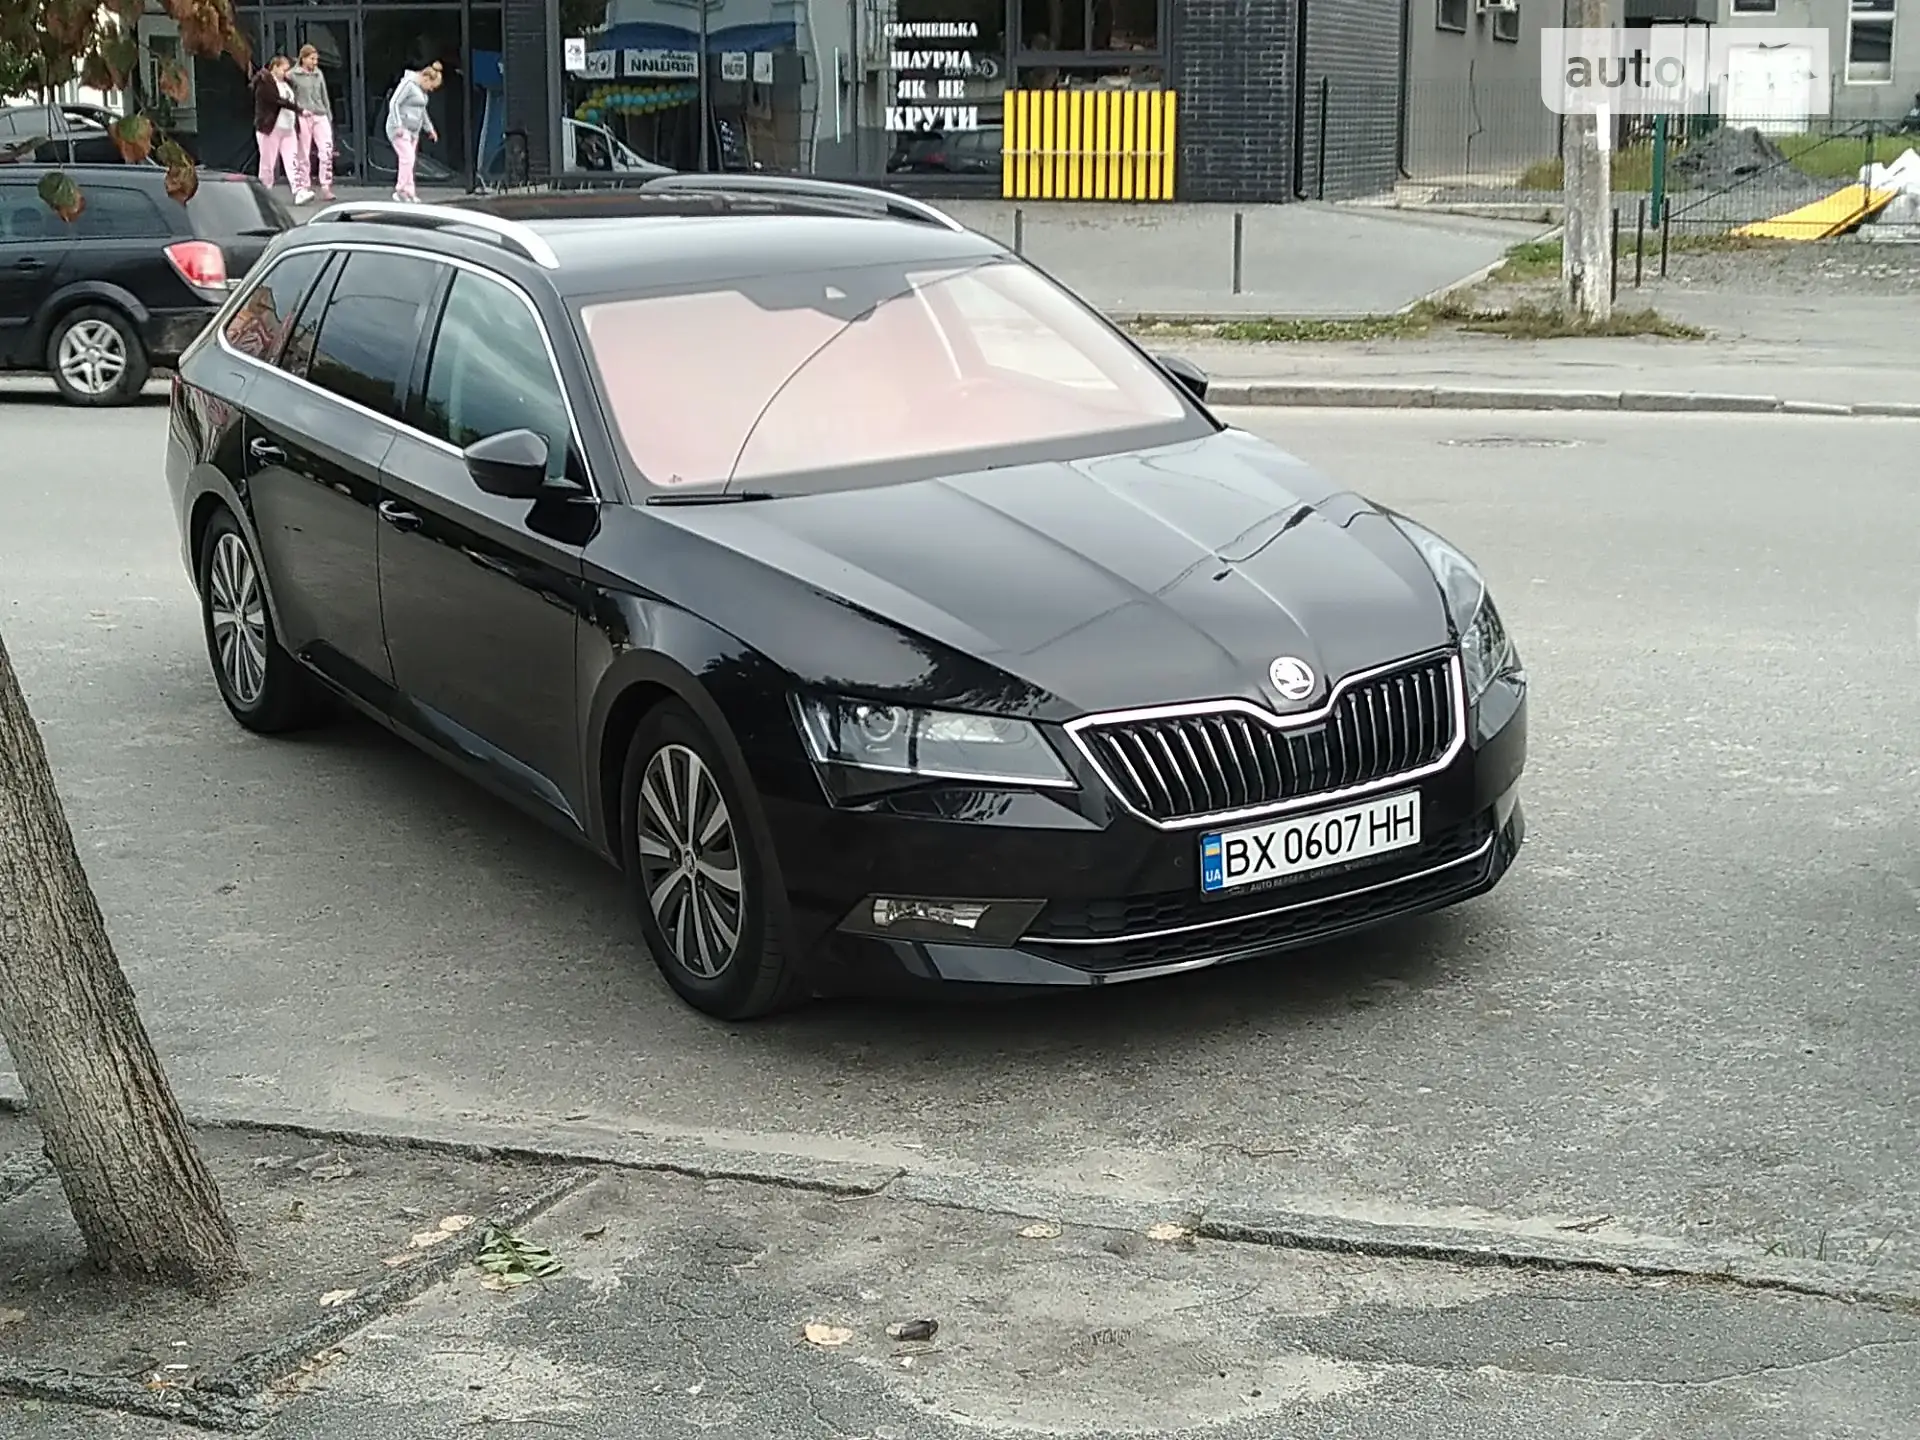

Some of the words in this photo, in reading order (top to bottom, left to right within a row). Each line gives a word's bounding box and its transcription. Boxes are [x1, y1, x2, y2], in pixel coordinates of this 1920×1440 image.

[884, 22, 978, 38] СМАЧНЕНЬКА
[890, 50, 972, 69] ШАУРМА
[897, 79, 926, 99] ЯК
[938, 79, 965, 99] НЕ
[885, 106, 978, 132] КРУТИ
[1225, 832, 1277, 879] BX
[1284, 813, 1362, 864] 0607
[1369, 800, 1415, 847] HH
[1205, 869, 1221, 883] UA
